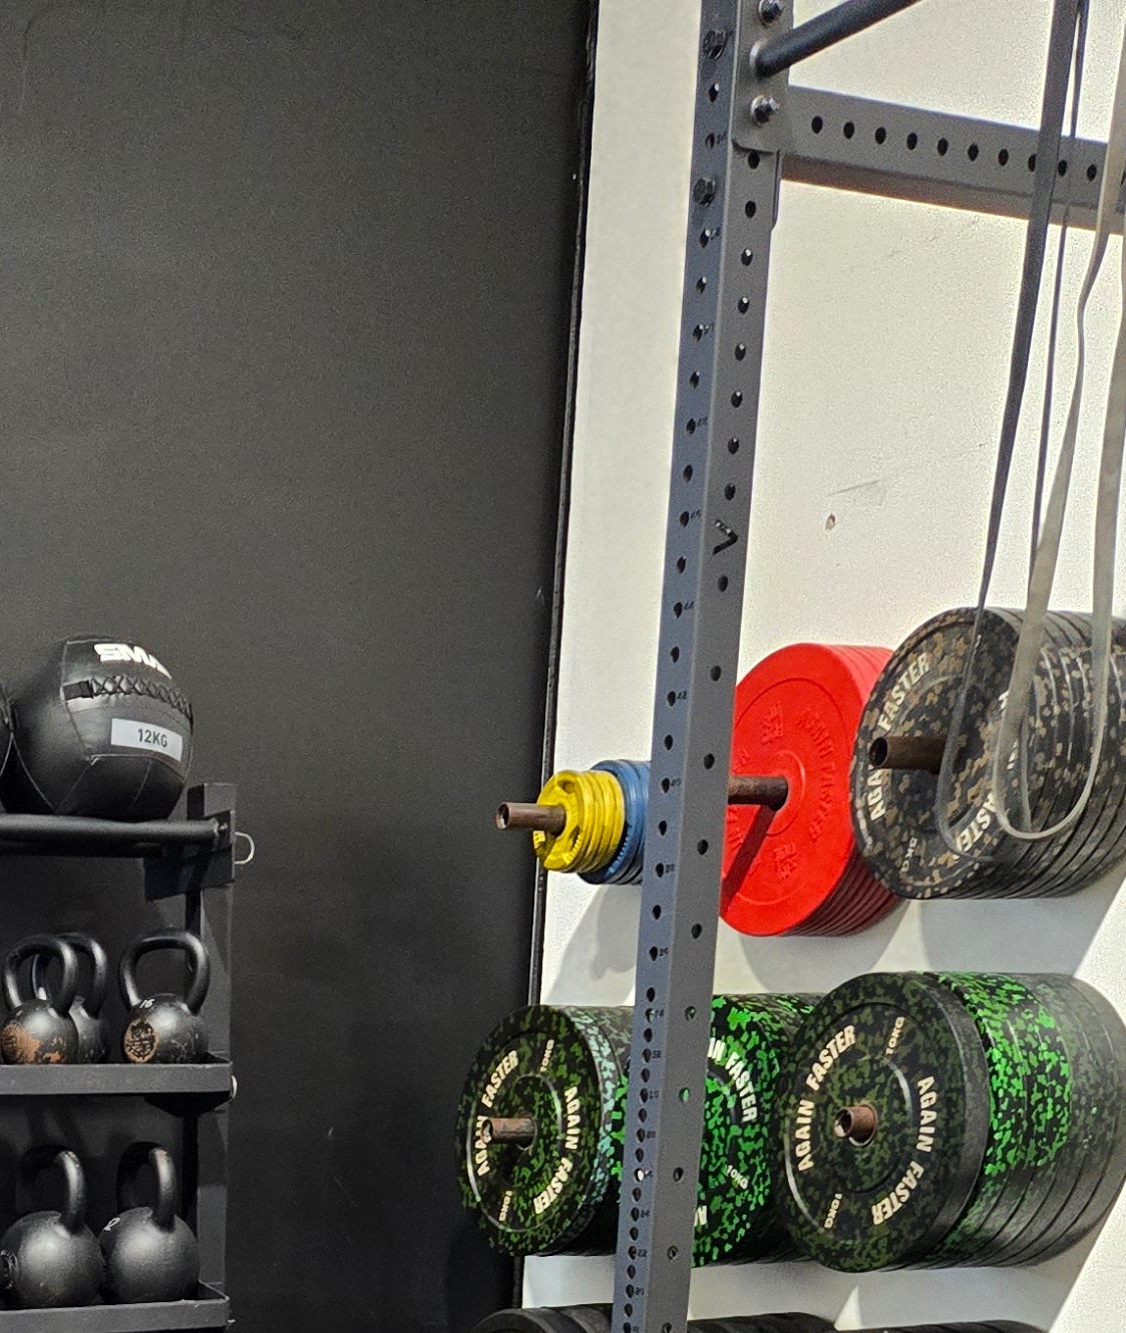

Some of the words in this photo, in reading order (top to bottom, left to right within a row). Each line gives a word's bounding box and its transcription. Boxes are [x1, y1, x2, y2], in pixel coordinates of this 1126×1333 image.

[877, 652, 930, 732] FASTER
[137, 728, 168, 748] 12KG
[885, 1016, 905, 1055] 10KG
[481, 1050, 519, 1109] FASTER
[725, 1051, 758, 1123] FASTER
[794, 1099, 815, 1172] AGAIN
[805, 1024, 856, 1092] FASTER
[564, 1085, 581, 1150] AGAIN
[916, 1075, 937, 1153] AGAIN
[532, 1157, 573, 1215] FASTER
[726, 1164, 749, 1190] 10KG
[871, 1160, 925, 1226] FASTER
[824, 1193, 843, 1229] 10KG
